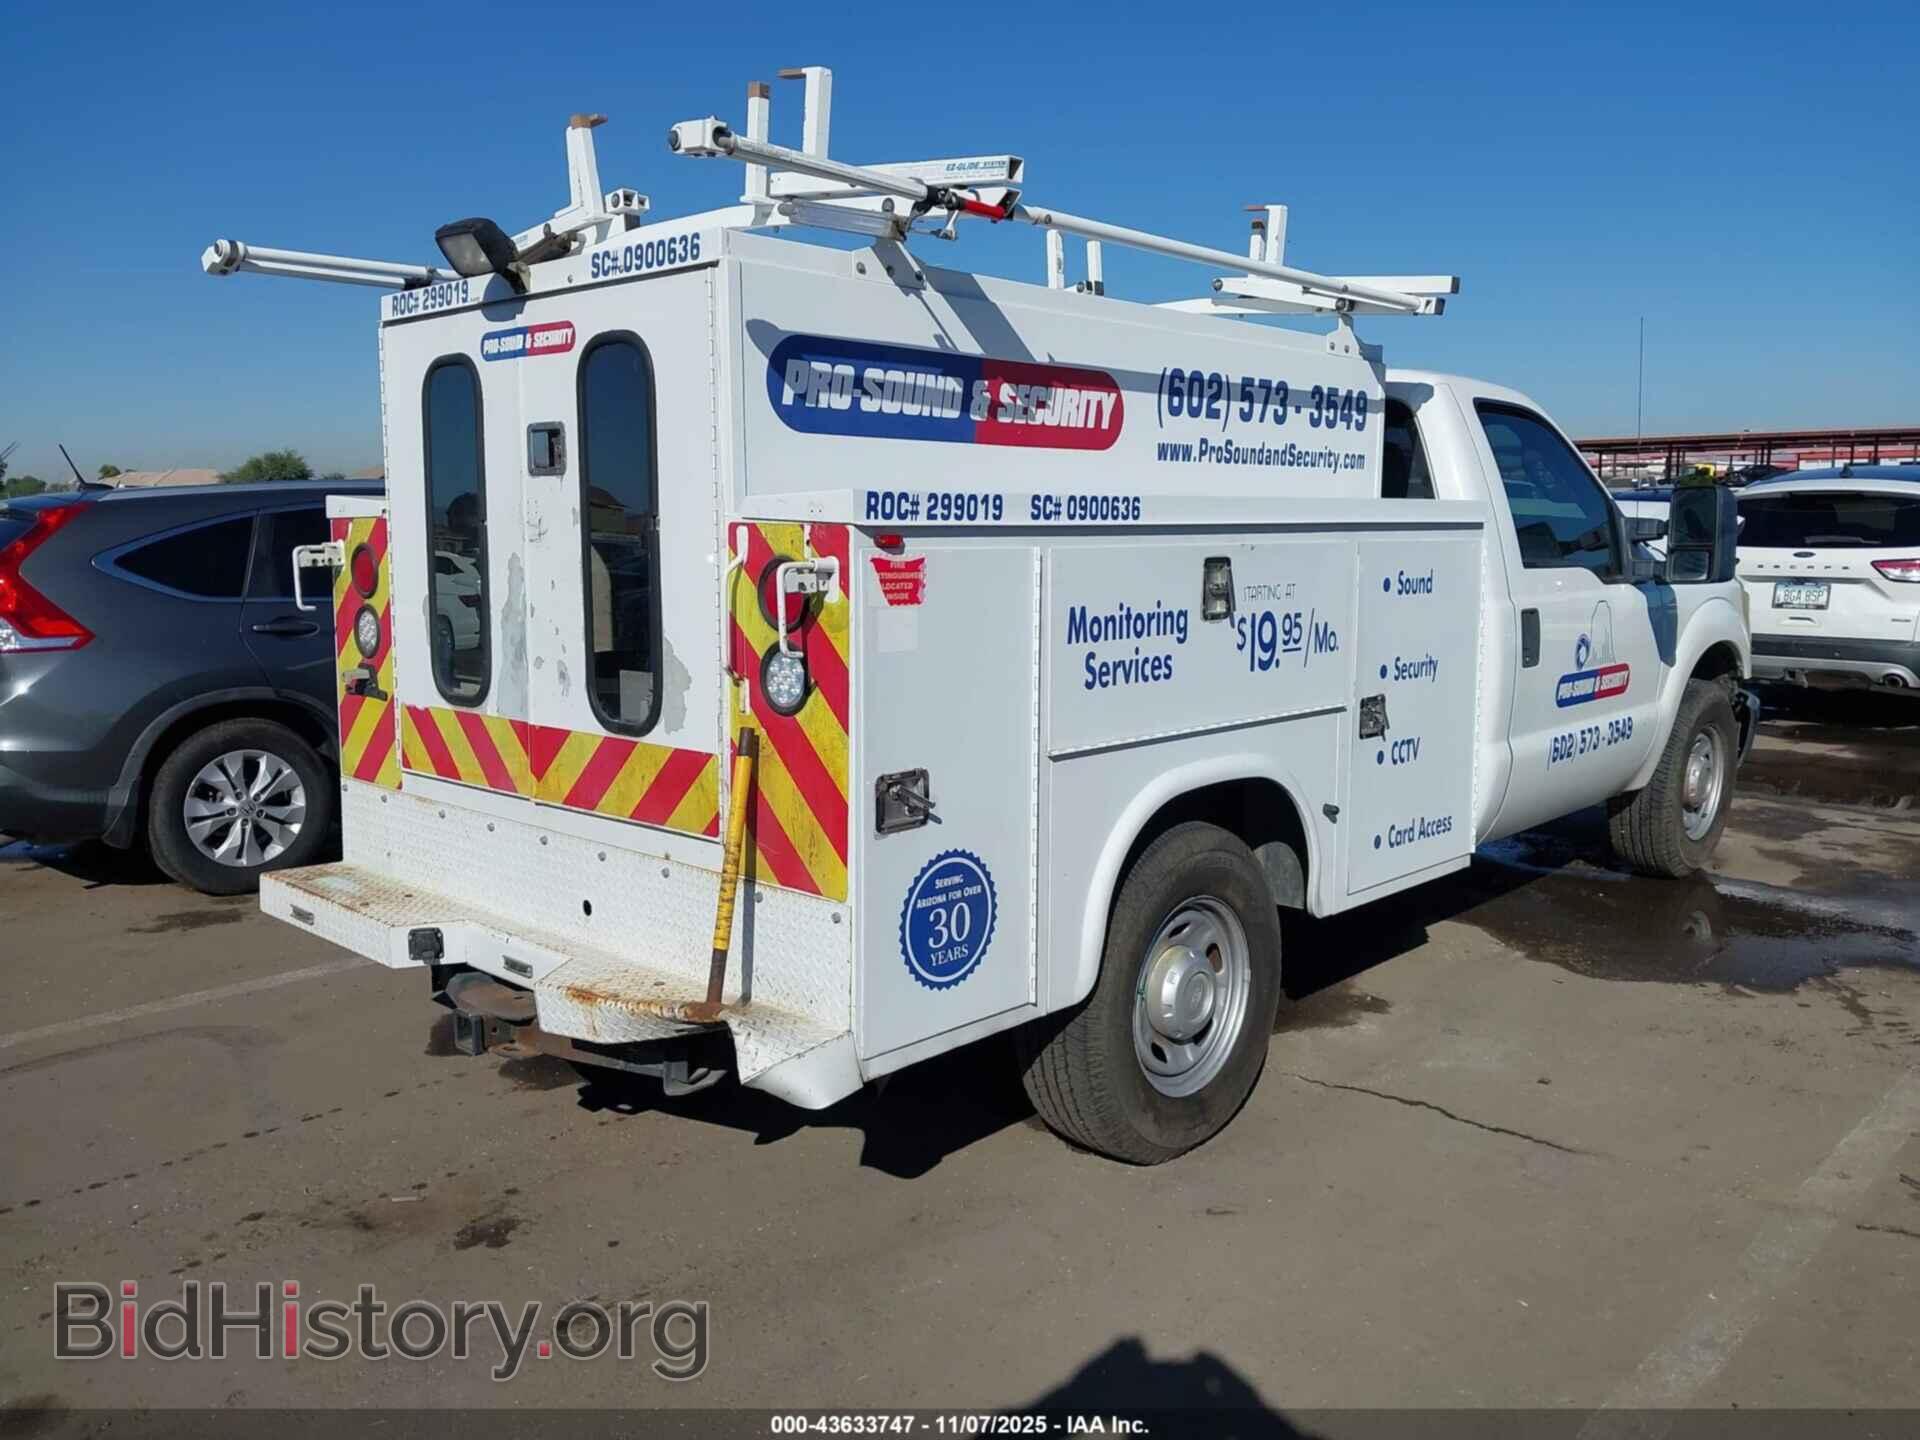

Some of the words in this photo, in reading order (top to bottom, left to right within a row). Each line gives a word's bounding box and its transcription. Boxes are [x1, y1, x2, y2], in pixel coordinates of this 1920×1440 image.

[591, 251, 620, 279] SC#
[623, 232, 701, 272] 0900636
[392, 290, 419, 317] ROC#
[422, 280, 469, 311] 299019
[781, 359, 964, 418] PRO-SOUND
[970, 380, 990, 422] &
[997, 383, 1118, 429] SECURITY
[1158, 367, 1231, 432] (602)
[1239, 376, 1289, 425] 573
[1309, 384, 1368, 431] 3549
[1157, 437, 1365, 474] www.ProSoundandSecurity.com
[866, 491, 919, 520] ROC#
[926, 493, 1004, 521] 299019
[1030, 494, 1062, 520] SC#
[1067, 494, 1141, 521] 0900636
[1285, 583, 1296, 600] AT
[1397, 568, 1433, 595] Sound
[1067, 600, 1188, 644] Monitoring
[1084, 647, 1172, 690] Services
[1393, 653, 1438, 682] Security
[1391, 737, 1420, 765] CCTV
[1547, 732, 1577, 772] (602)
[1579, 725, 1600, 755] 573
[1608, 716, 1633, 747] 3549
[1388, 818, 1415, 848] Card
[1418, 816, 1452, 840] Access
[928, 902, 970, 948] 30
[930, 944, 969, 966] YEARS
